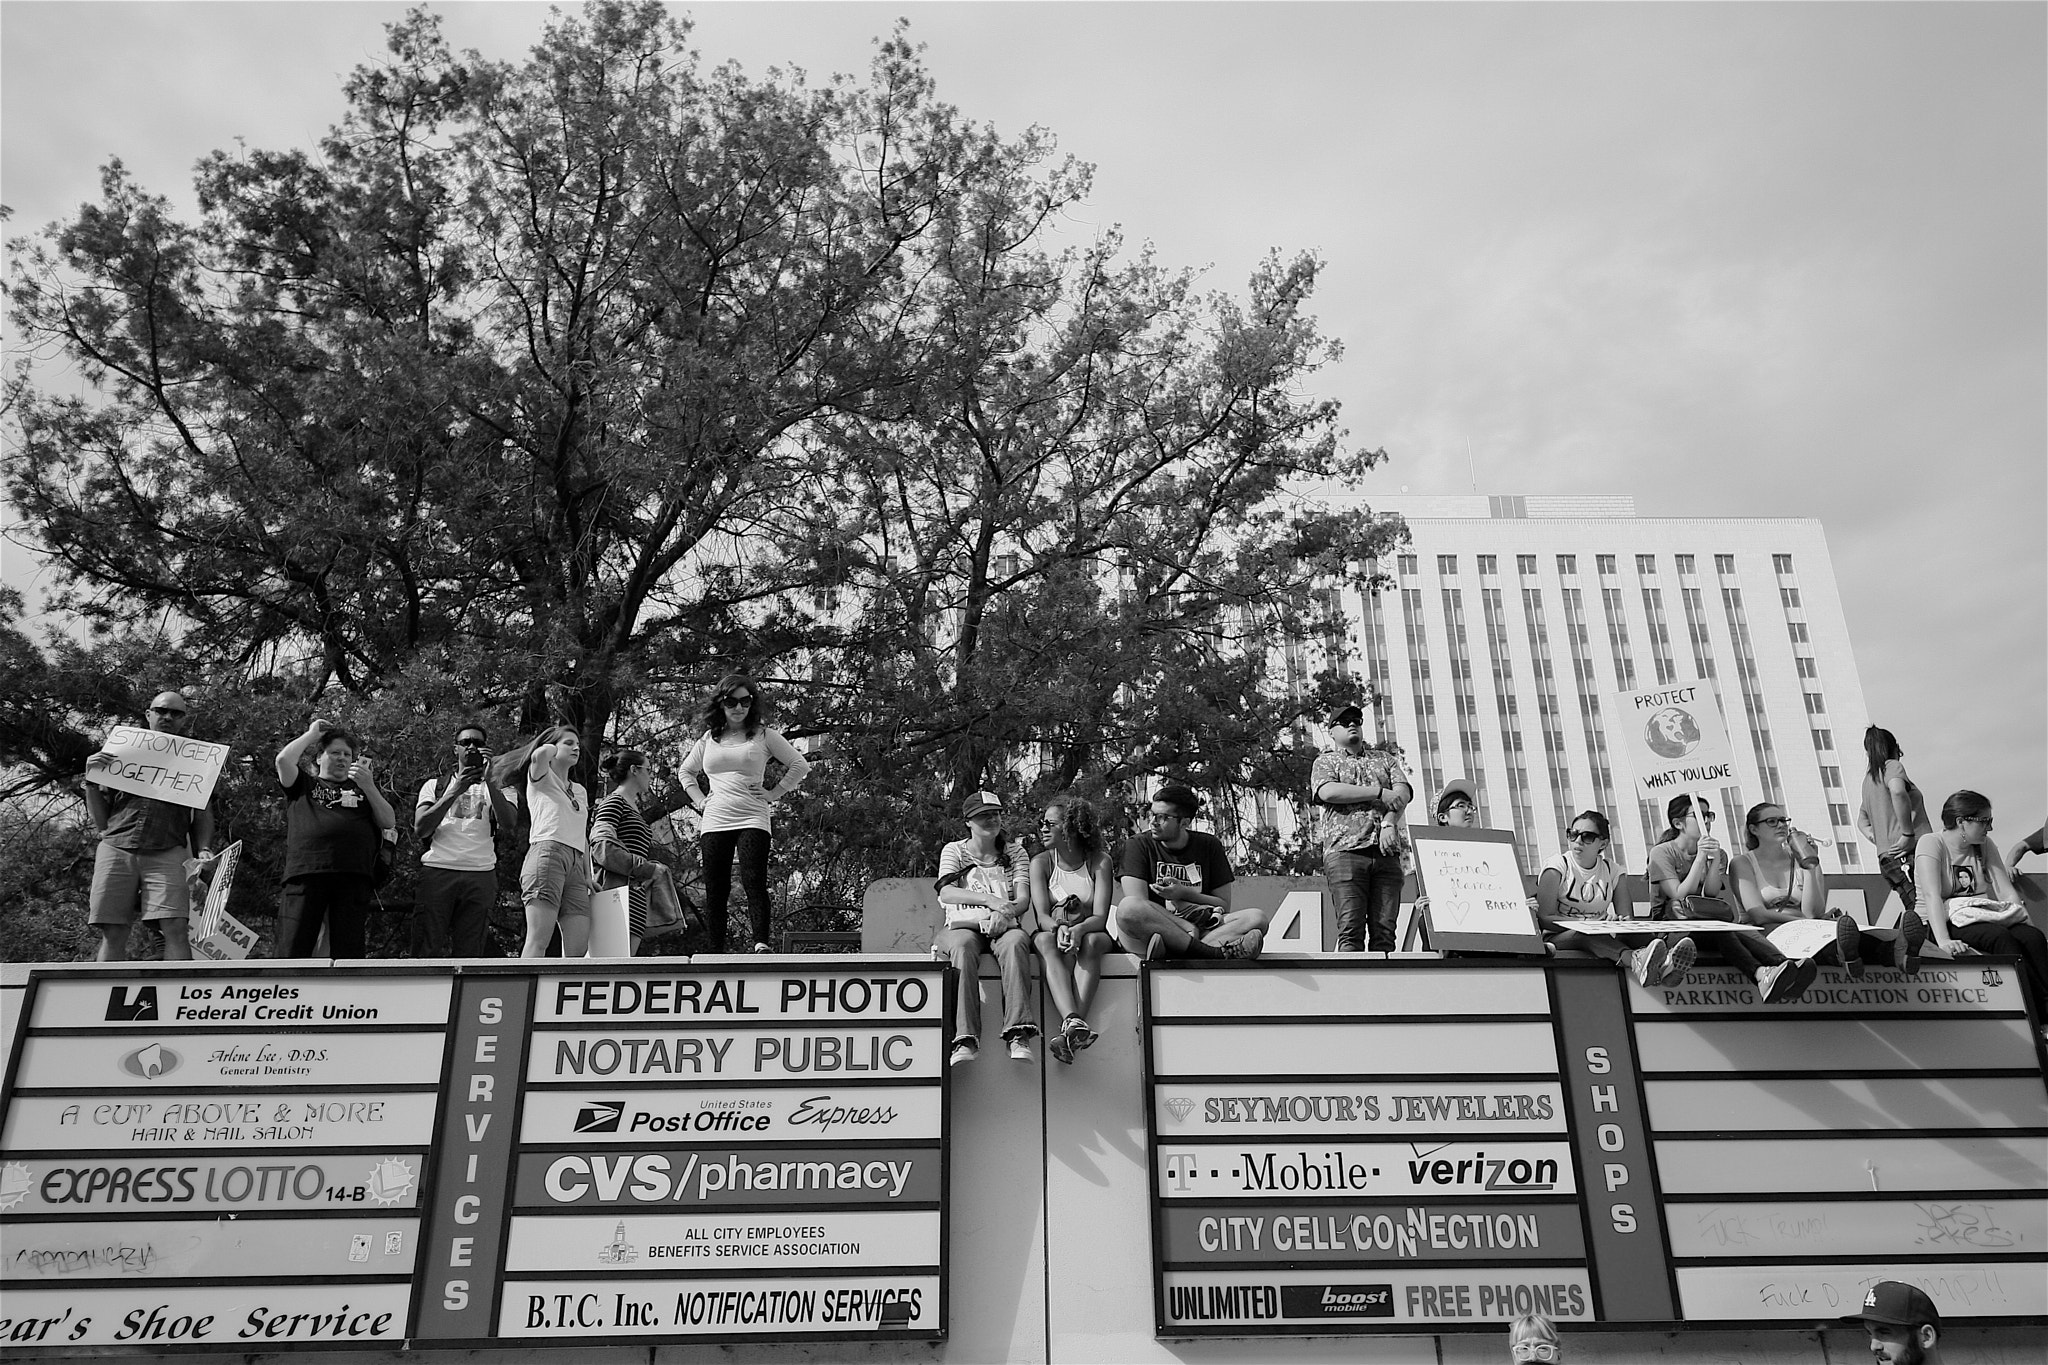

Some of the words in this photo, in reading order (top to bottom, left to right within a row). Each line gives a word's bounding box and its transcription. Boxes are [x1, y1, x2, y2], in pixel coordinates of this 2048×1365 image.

[1634, 687, 1697, 709] PROTECT
[109, 729, 222, 765] STRONGER
[101, 759, 204, 793] OGETHER
[1643, 771, 1677, 789] WHAT
[1679, 767, 1701, 783] YOU
[1701, 763, 1732, 781] LOVE
[1159, 863, 1200, 880] CAUTI
[1484, 899, 1518, 911] BABY!
[1686, 972, 1751, 985] DEPART
[180, 985, 212, 1001] Los
[220, 984, 300, 1003] Angeles
[555, 980, 759, 1015] FEDERAL
[780, 978, 928, 1013] PHOTO
[1663, 990, 1754, 1005] PARKING
[1778, 988, 1909, 1005] UDICATION
[1917, 988, 1989, 1004] OFFICE
[175, 1005, 247, 1020] Federal
[254, 1005, 314, 1020] Credit
[321, 1004, 379, 1019] Union
[207, 1045, 251, 1063] Arlene
[287, 1049, 329, 1062] D.D.S.
[555, 1038, 733, 1074] NOTARY
[754, 1035, 913, 1072] PUBLIC
[220, 1066, 260, 1076] General
[264, 1065, 312, 1077] Dentistry
[60, 1104, 80, 1125] A
[93, 1104, 152, 1125] CUT
[162, 1102, 262, 1124] ABOVE
[273, 1103, 292, 1122] &
[305, 1101, 386, 1123] MORE
[700, 1100, 736, 1109] United
[738, 1099, 772, 1109] States
[787, 1096, 898, 1133] Express
[1204, 1095, 1381, 1123] SEYMOUR'S
[1388, 1094, 1555, 1122] JEWELERS
[131, 1127, 178, 1142] HAIR
[184, 1128, 196, 1141] &
[203, 1126, 245, 1141] NAIL
[252, 1126, 314, 1140] SALON
[1585, 1046, 1638, 1234] SHOPS
[443, 997, 503, 1310] SERVICES
[544, 1153, 913, 1202] CVS/pharmacy
[1407, 1151, 1558, 1191] verizon
[40, 1167, 198, 1203] EXPRESS
[205, 1165, 325, 1202] LOTTO
[325, 1186, 366, 1202] 14-B
[685, 1228, 709, 1241] ALL
[713, 1227, 744, 1240] CITY
[746, 1226, 826, 1239] EMPLOYEES
[1199, 1216, 1265, 1252] CITY
[1272, 1215, 1346, 1251] CELL
[1354, 1207, 1540, 1257] CONNECTION
[648, 1245, 711, 1258] BENEFITS
[715, 1244, 770, 1257] SERVICE
[773, 1243, 860, 1256] ASSOCIATION
[1169, 1285, 1278, 1320] UNLIMITED
[1320, 1286, 1389, 1305] boost
[1405, 1285, 1473, 1317] FREE
[1478, 1284, 1586, 1317] PHONES
[1759, 1283, 1814, 1307] Fuck
[525, 1293, 603, 1329] B.T.C.
[613, 1293, 659, 1327] Inc.
[674, 1290, 820, 1325] NOTIFICATION
[1323, 1303, 1367, 1313] mobile
[114, 1304, 215, 1340] Shoe
[238, 1304, 393, 1338] Service
